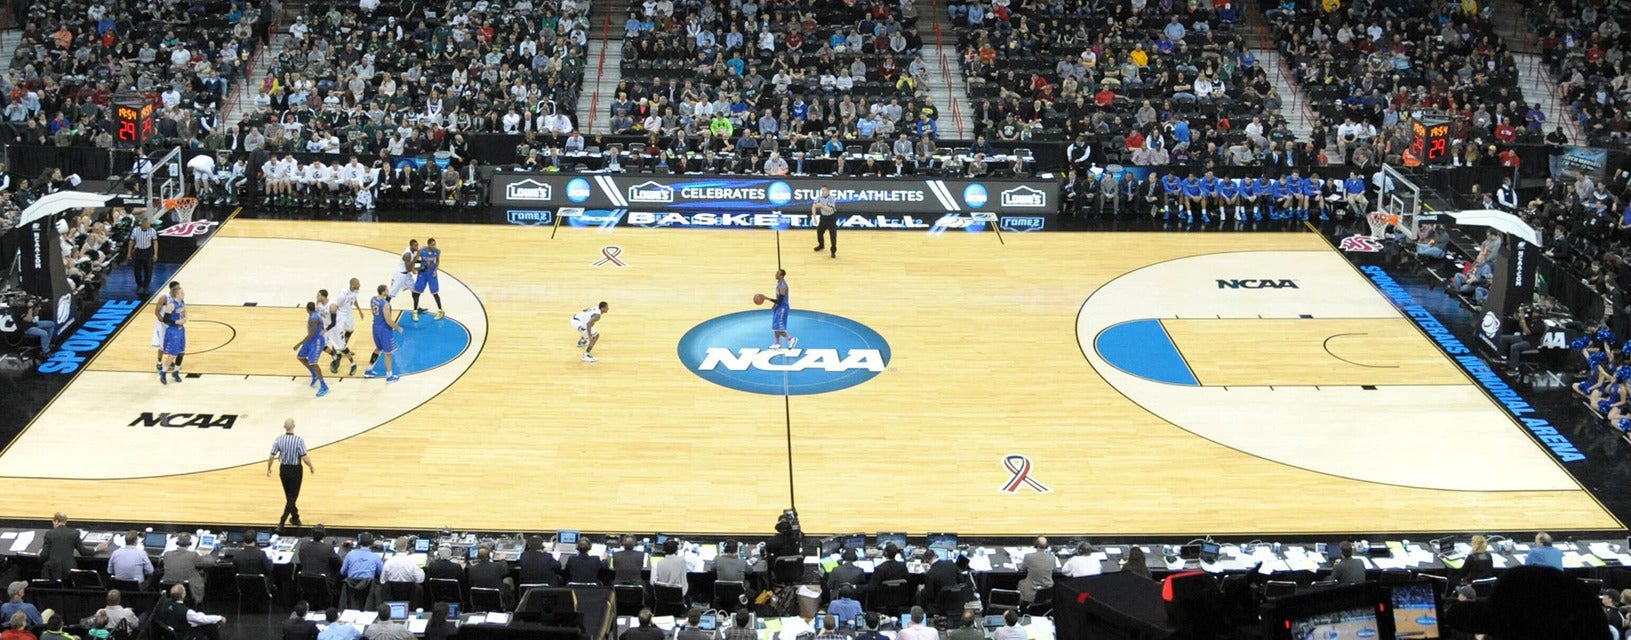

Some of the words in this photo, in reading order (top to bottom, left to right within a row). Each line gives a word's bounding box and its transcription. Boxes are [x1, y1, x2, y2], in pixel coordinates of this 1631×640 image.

[119, 120, 136, 141] 29
[1429, 138, 1446, 159] 29
[681, 188, 765, 200] CELEBRATES
[794, 189, 924, 202] STUENT-ATHLETES
[627, 211, 930, 228] BASKETALL
[1215, 279, 1299, 289] NCAA
[38, 299, 142, 374] SPOKANE
[698, 346, 887, 372] NCAA
[1403, 304, 1471, 354] VETERANS
[1454, 355, 1536, 417] MEMORIAL
[1519, 417, 1587, 463] ARENA
[127, 411, 239, 430] NCAA
